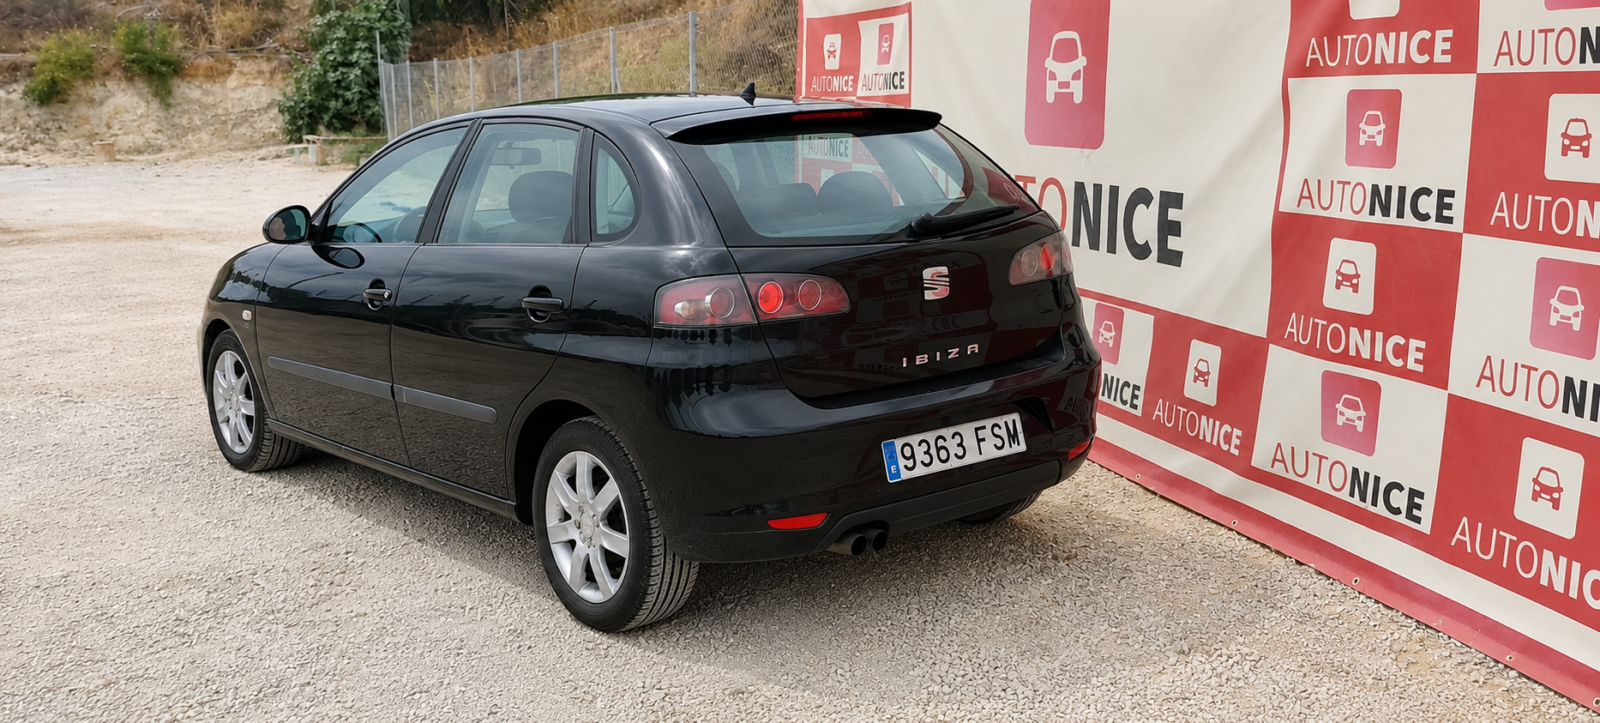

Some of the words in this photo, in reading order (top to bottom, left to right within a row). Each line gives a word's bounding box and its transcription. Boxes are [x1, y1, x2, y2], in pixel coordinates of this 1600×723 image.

[1305, 29, 1453, 67] AUTONICE
[811, 75, 854, 92] AUTONICE
[861, 71, 905, 92] AUTONICE
[1296, 178, 1456, 225] AUTONICE
[902, 344, 979, 367] IBIZA
[1284, 312, 1426, 373] AUTONICE
[900, 431, 967, 472] 9363
[974, 419, 1021, 456] FSM
[1152, 398, 1242, 457] AUTONICE
[1270, 442, 1425, 525] AUTONICE
